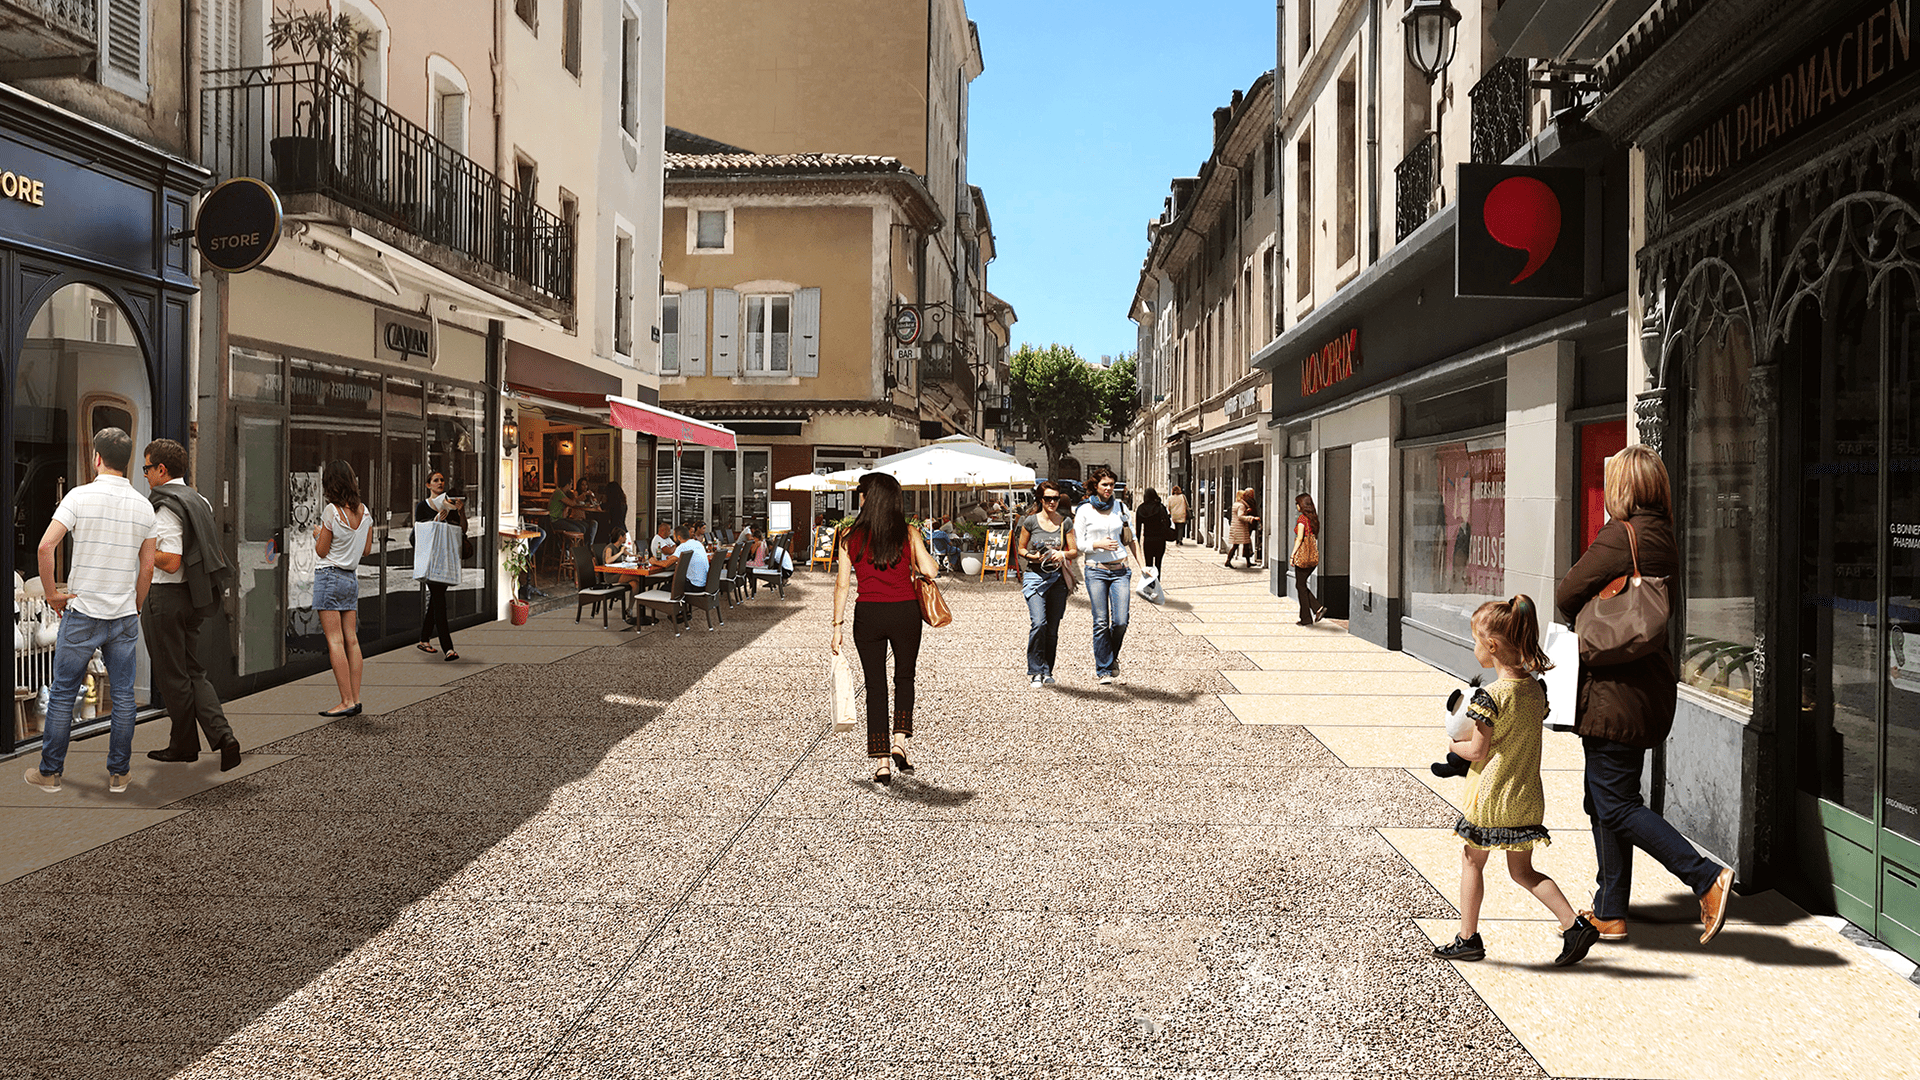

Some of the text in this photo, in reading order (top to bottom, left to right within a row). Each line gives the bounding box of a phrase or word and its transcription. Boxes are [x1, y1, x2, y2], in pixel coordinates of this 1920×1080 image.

[1736, 0, 1910, 161] PHARMACIEN
[0, 167, 44, 207] ORE
[210, 232, 260, 251] STORE
[898, 349, 913, 359] BAR
[1301, 328, 1358, 397] MONOPRIX
